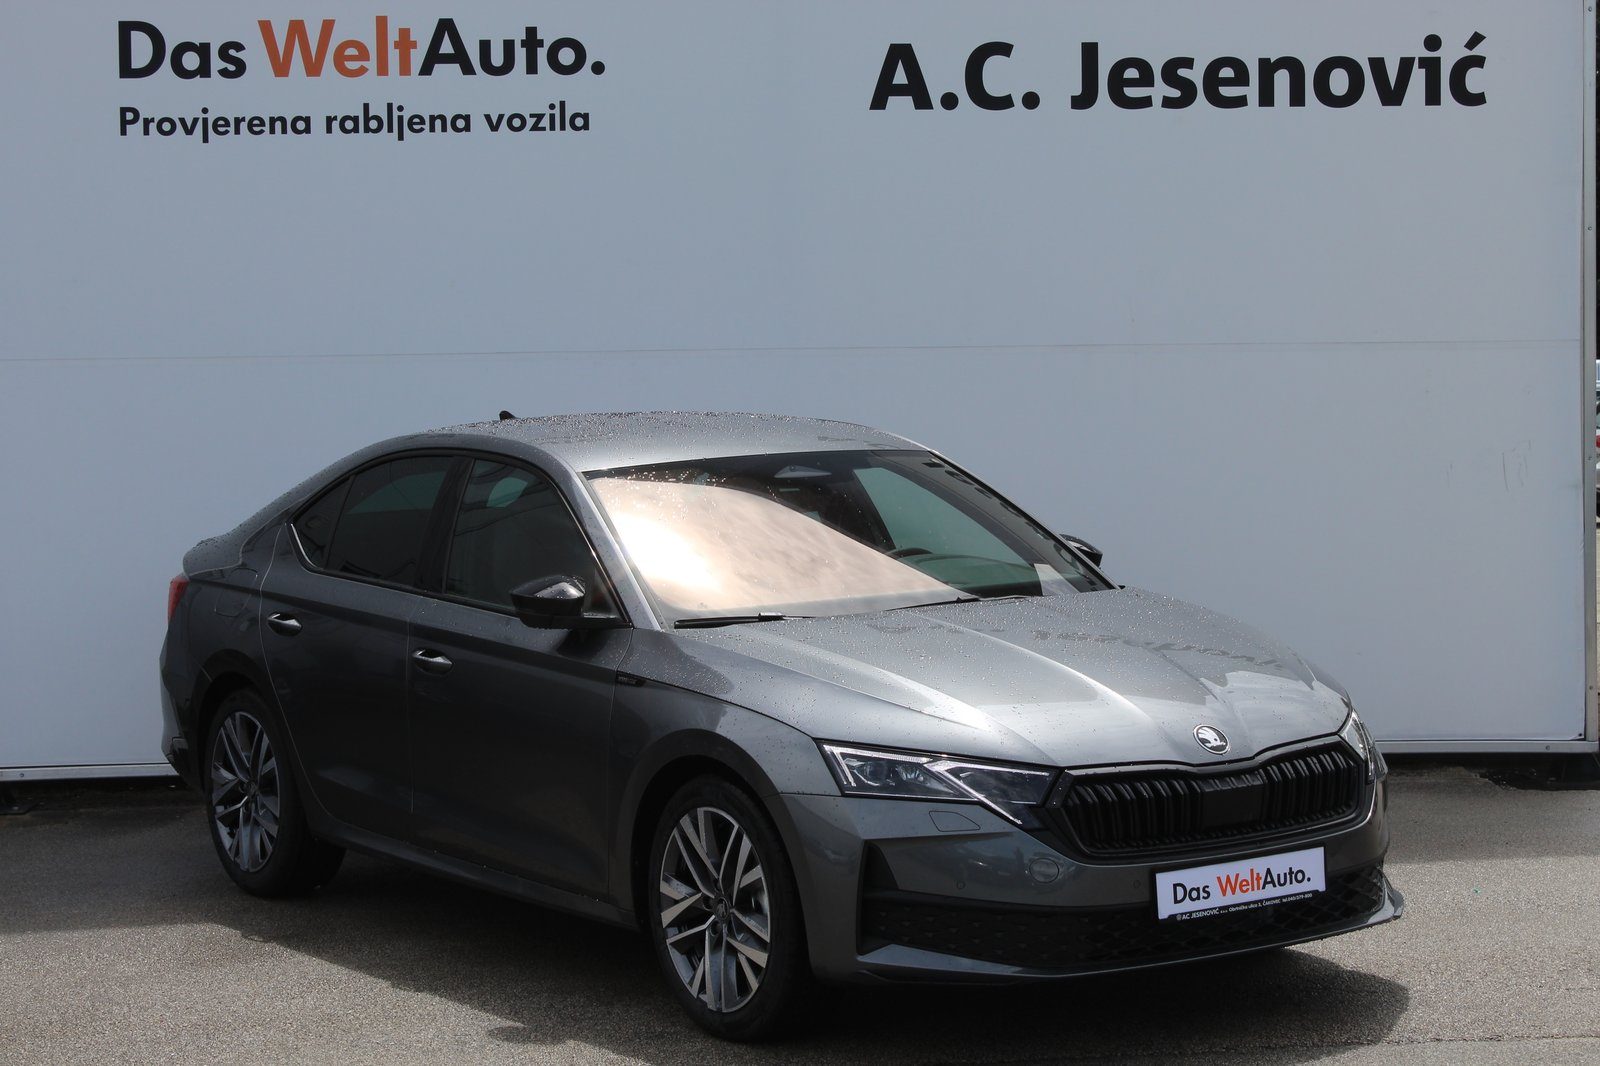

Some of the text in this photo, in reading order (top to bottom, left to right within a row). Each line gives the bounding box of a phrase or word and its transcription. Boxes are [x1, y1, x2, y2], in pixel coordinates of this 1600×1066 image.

[118, 16, 606, 79] Das WeltAuto.
[869, 31, 1487, 111] A.C. Jesenović
[119, 100, 590, 143] Provjerena rabljena vozila
[1173, 867, 1311, 904] Das WeltAuto.
